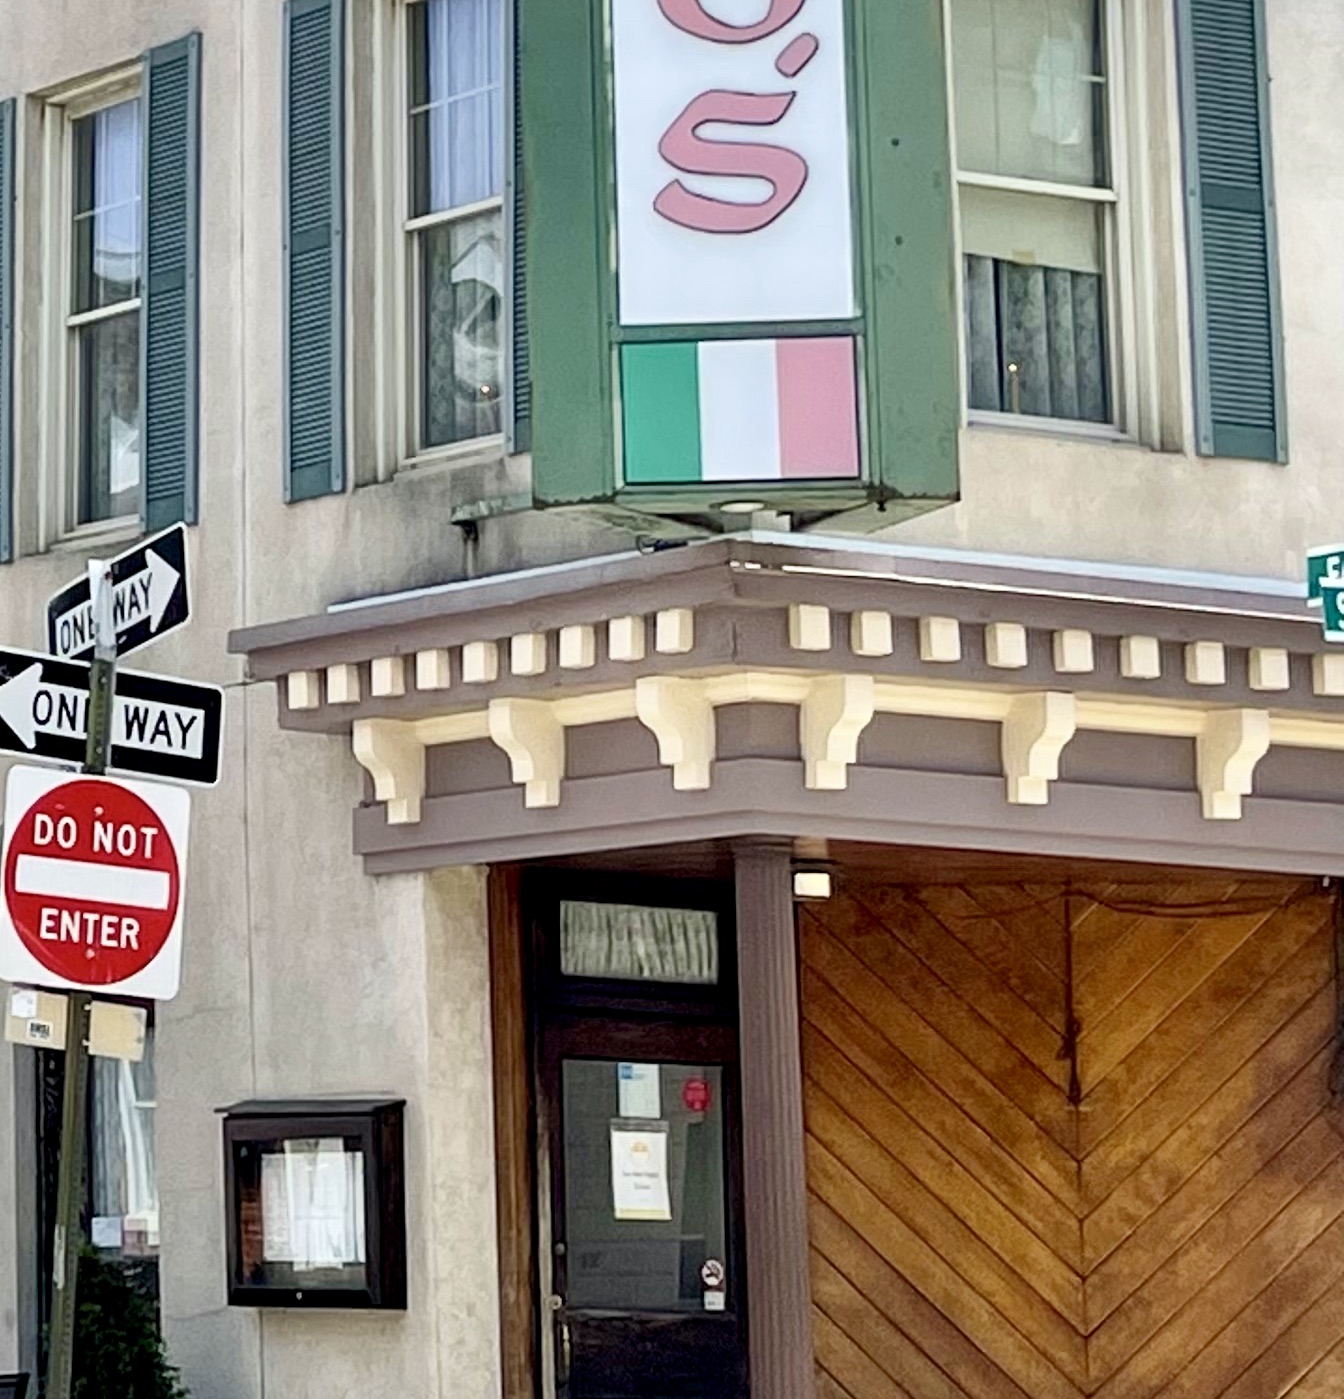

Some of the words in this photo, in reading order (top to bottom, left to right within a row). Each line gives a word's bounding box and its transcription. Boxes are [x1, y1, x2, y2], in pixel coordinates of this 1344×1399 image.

[113, 571, 153, 628] WAY
[124, 704, 198, 750] WAY
[33, 813, 78, 849] DO
[93, 820, 159, 860] NOT
[39, 907, 141, 951] ENTER
